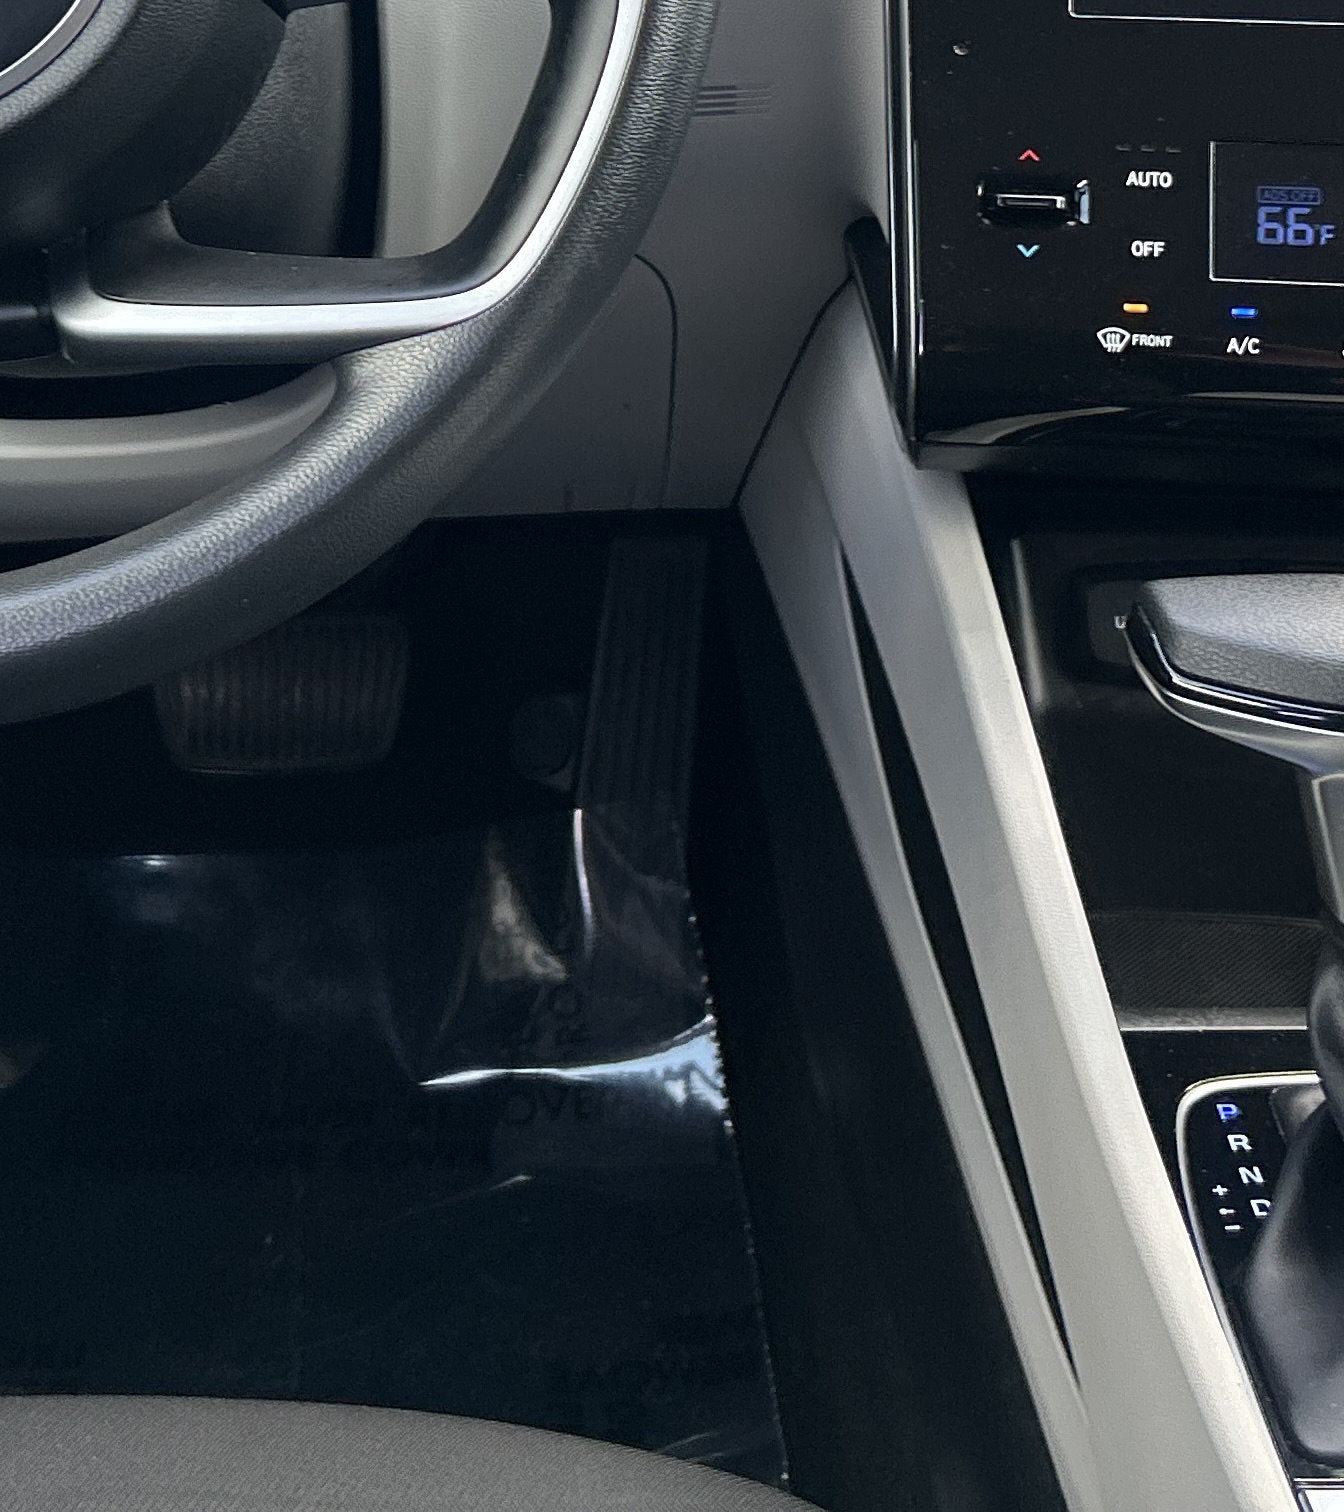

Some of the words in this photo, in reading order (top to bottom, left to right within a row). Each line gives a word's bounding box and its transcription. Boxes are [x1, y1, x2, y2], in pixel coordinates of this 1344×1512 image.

[1125, 170, 1173, 188] AUTO
[1256, 206, 1314, 246] 66
[1131, 240, 1165, 257] OFF
[1131, 335, 1173, 347] FRONT
[1226, 336, 1260, 355] A/C
[1216, 1103, 1240, 1121] P
[1226, 1134, 1253, 1151] R
[1238, 1166, 1265, 1183] N
